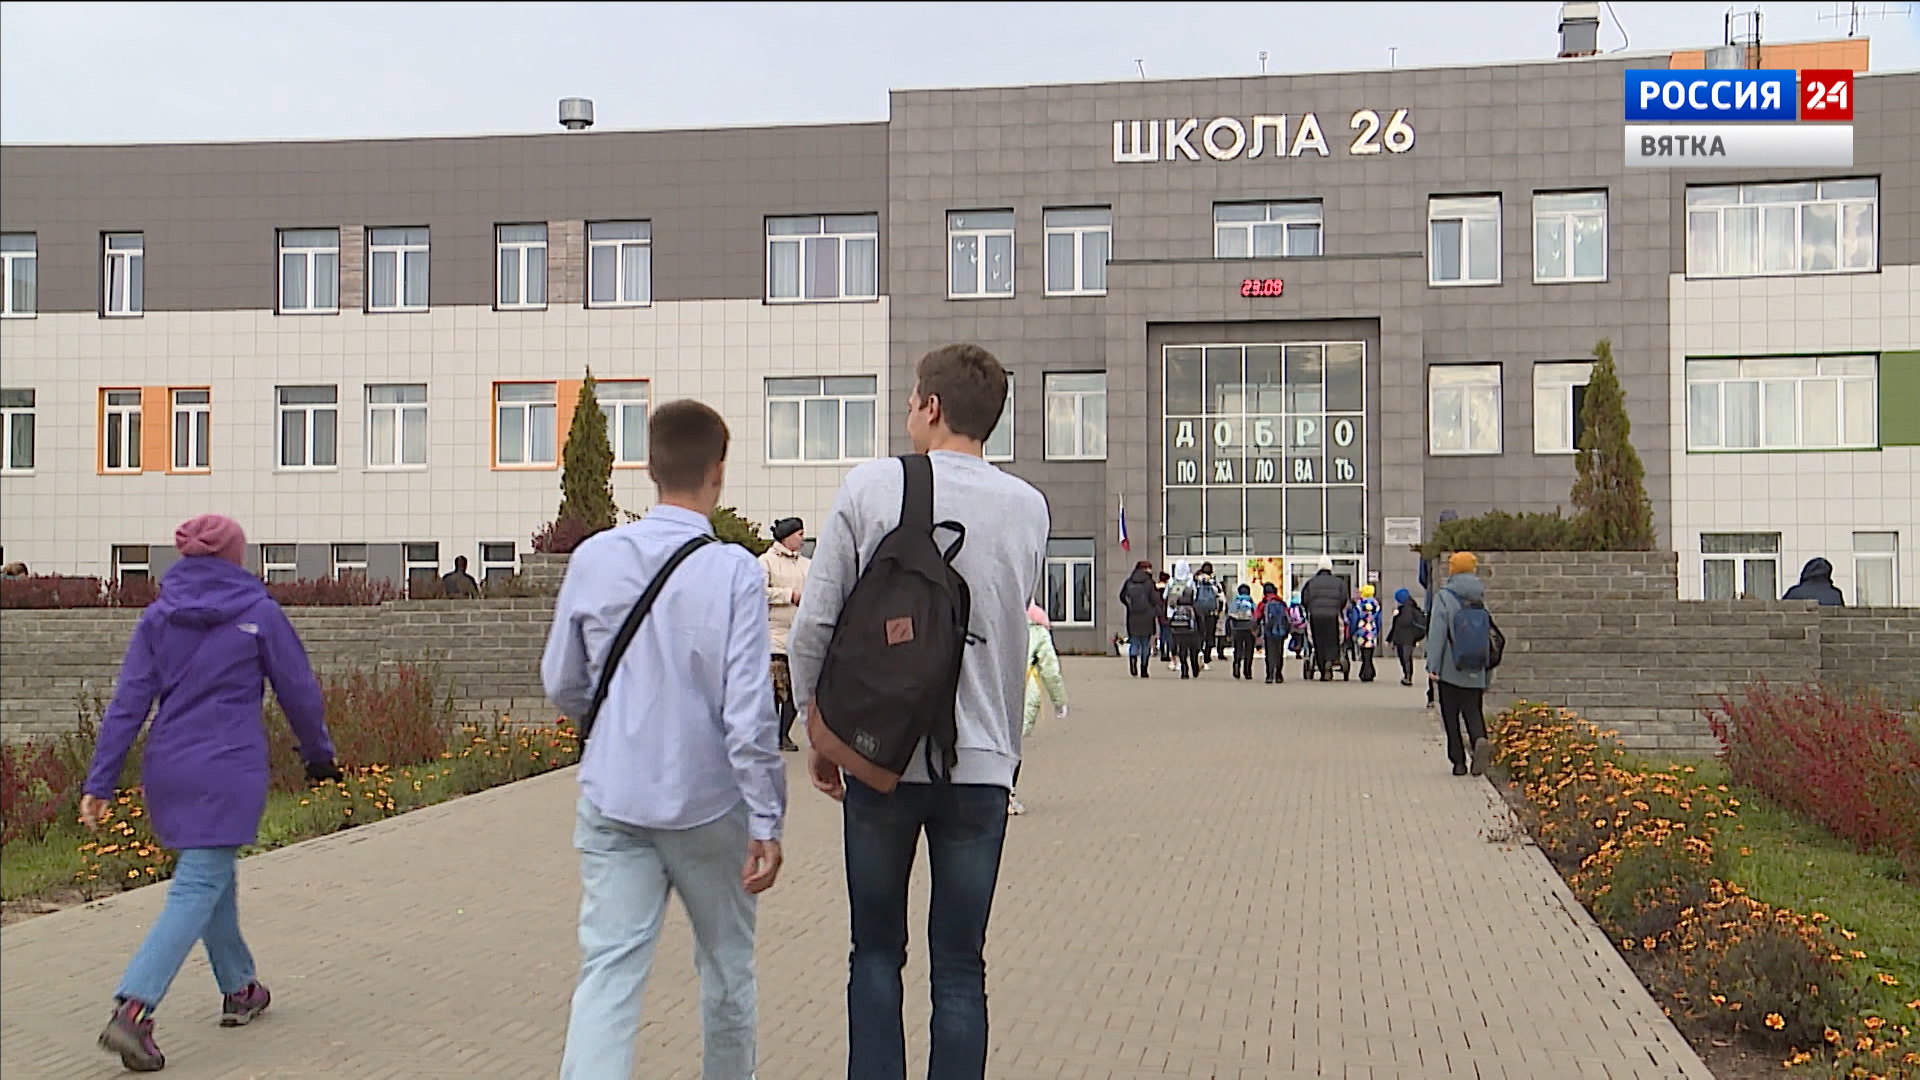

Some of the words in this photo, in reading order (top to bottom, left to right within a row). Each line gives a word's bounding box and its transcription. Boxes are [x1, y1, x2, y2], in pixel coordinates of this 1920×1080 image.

[1112, 112, 1330, 163] ШКОЛА
[1349, 108, 1416, 155] 26
[1175, 419, 1355, 448] ДОБРО
